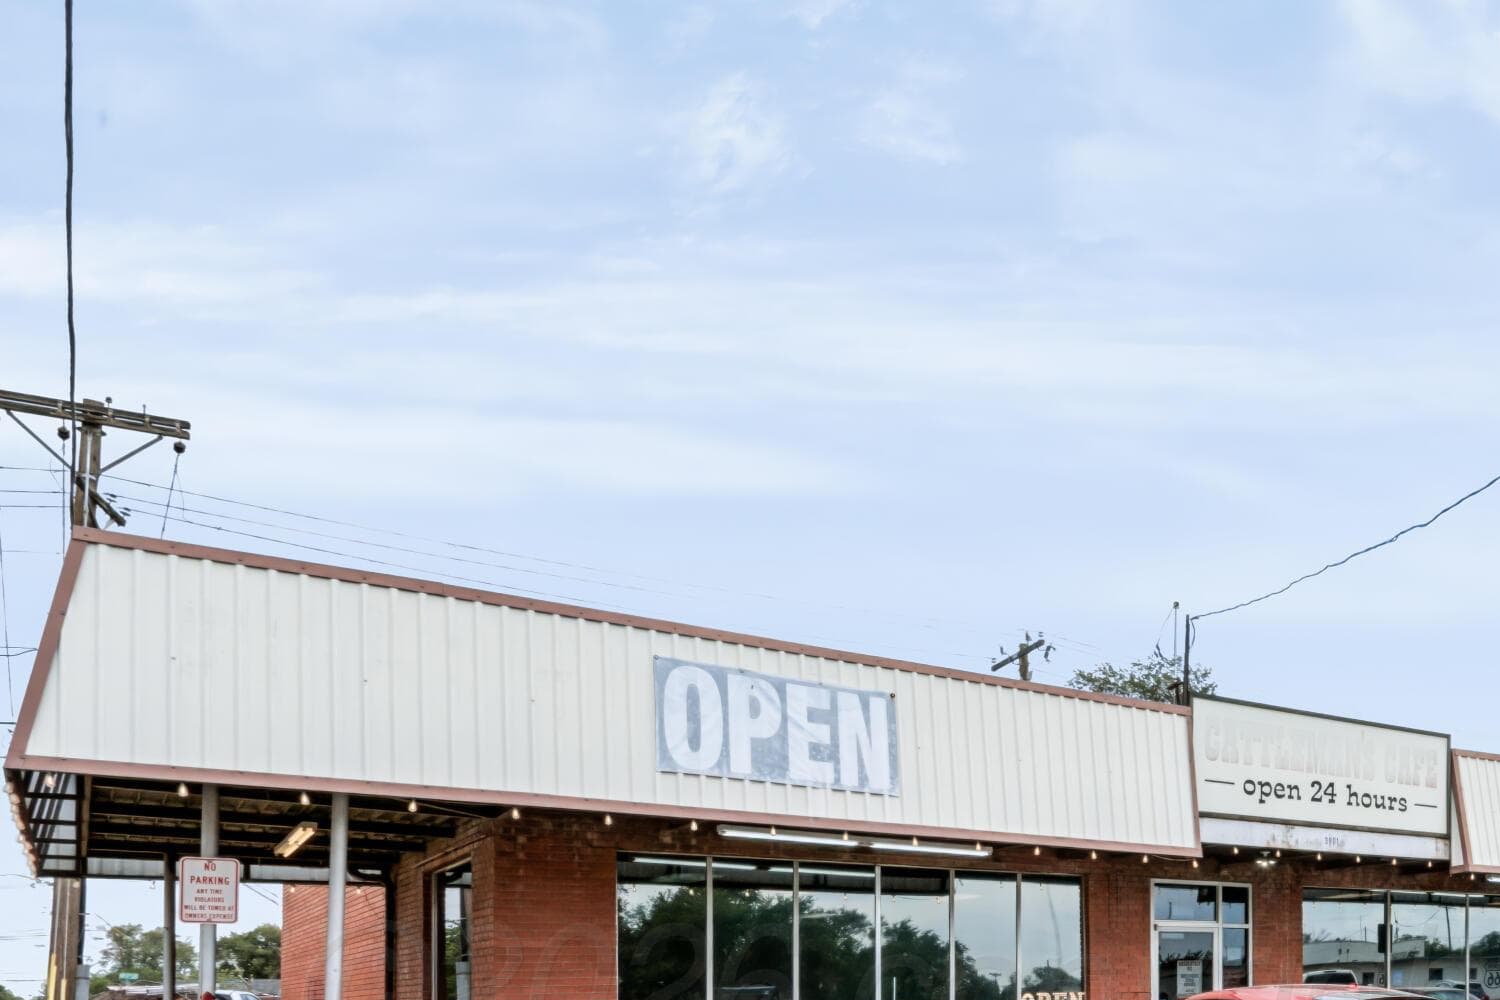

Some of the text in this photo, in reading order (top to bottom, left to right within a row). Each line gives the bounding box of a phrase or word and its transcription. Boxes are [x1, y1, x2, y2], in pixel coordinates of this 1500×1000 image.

[662, 665, 890, 787] OPEN
[1384, 742, 1438, 789] CAFE
[1243, 779, 1408, 812] open 24 hours
[190, 875, 230, 886] PARKING
[204, 862, 216, 871] NO
